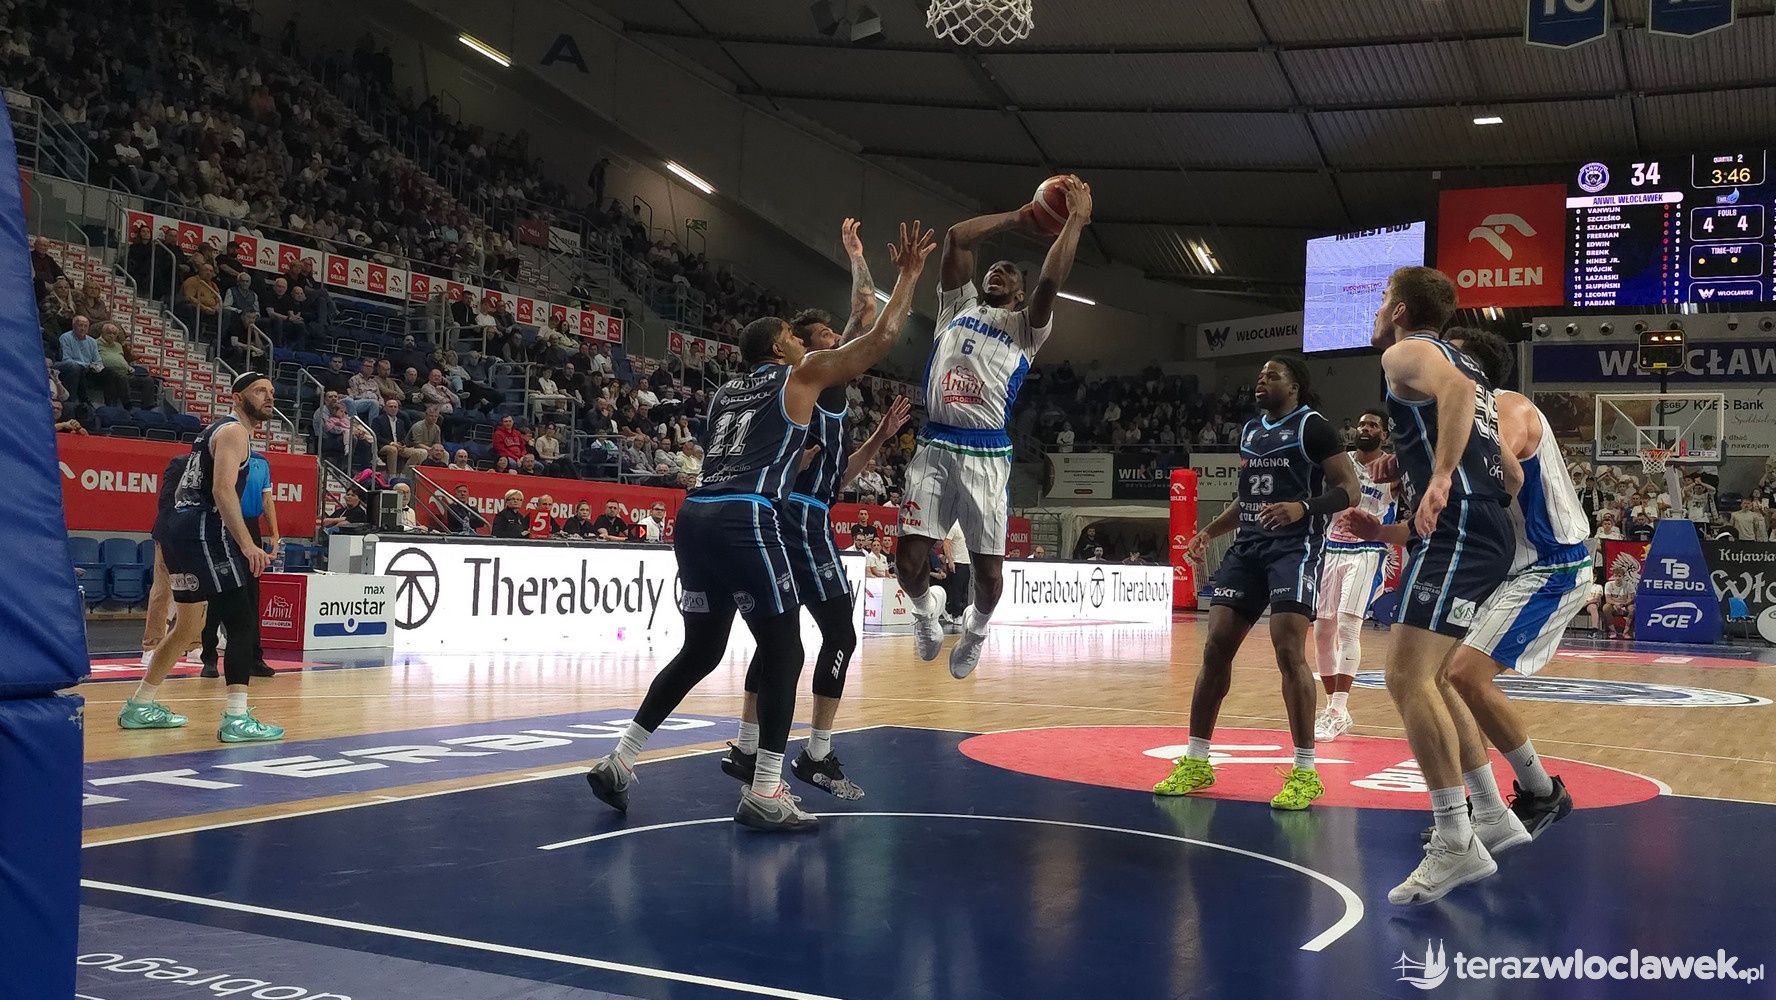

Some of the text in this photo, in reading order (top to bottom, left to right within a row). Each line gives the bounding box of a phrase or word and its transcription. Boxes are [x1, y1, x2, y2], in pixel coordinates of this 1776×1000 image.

[540, 33, 590, 74] A
[1737, 153, 1743, 163] 2
[1630, 161, 1661, 186] 34
[1711, 167, 1751, 184] 3:46
[1593, 197, 1616, 206] ANWIL
[1717, 209, 1737, 217] FOULS
[1702, 215, 1748, 233] 4 4
[1711, 246, 1742, 254] TIME-OUT
[1457, 265, 1544, 289] ORLEN
[1585, 265, 1613, 273] WÓJCIK
[1235, 323, 1299, 343] WŁOCŁAWEK
[960, 338, 976, 355] 6
[1598, 347, 1776, 376] WCŁAW
[1733, 399, 1764, 410] Bank
[706, 410, 757, 458] 11
[1249, 458, 1290, 468] MAGNOR
[80, 469, 158, 494] ORLEN
[1248, 473, 1274, 496] 23
[271, 482, 303, 502] LEN
[532, 511, 548, 532] 5
[1660, 558, 1690, 579] TB
[363, 585, 385, 595] max
[463, 556, 665, 630] Therabody
[1011, 568, 1171, 613] Therabody Therabody
[1643, 579, 1705, 592] TERBUD
[262, 598, 293, 619] Anwil
[319, 597, 386, 616] anvistar
[1647, 613, 1692, 629] PGE
